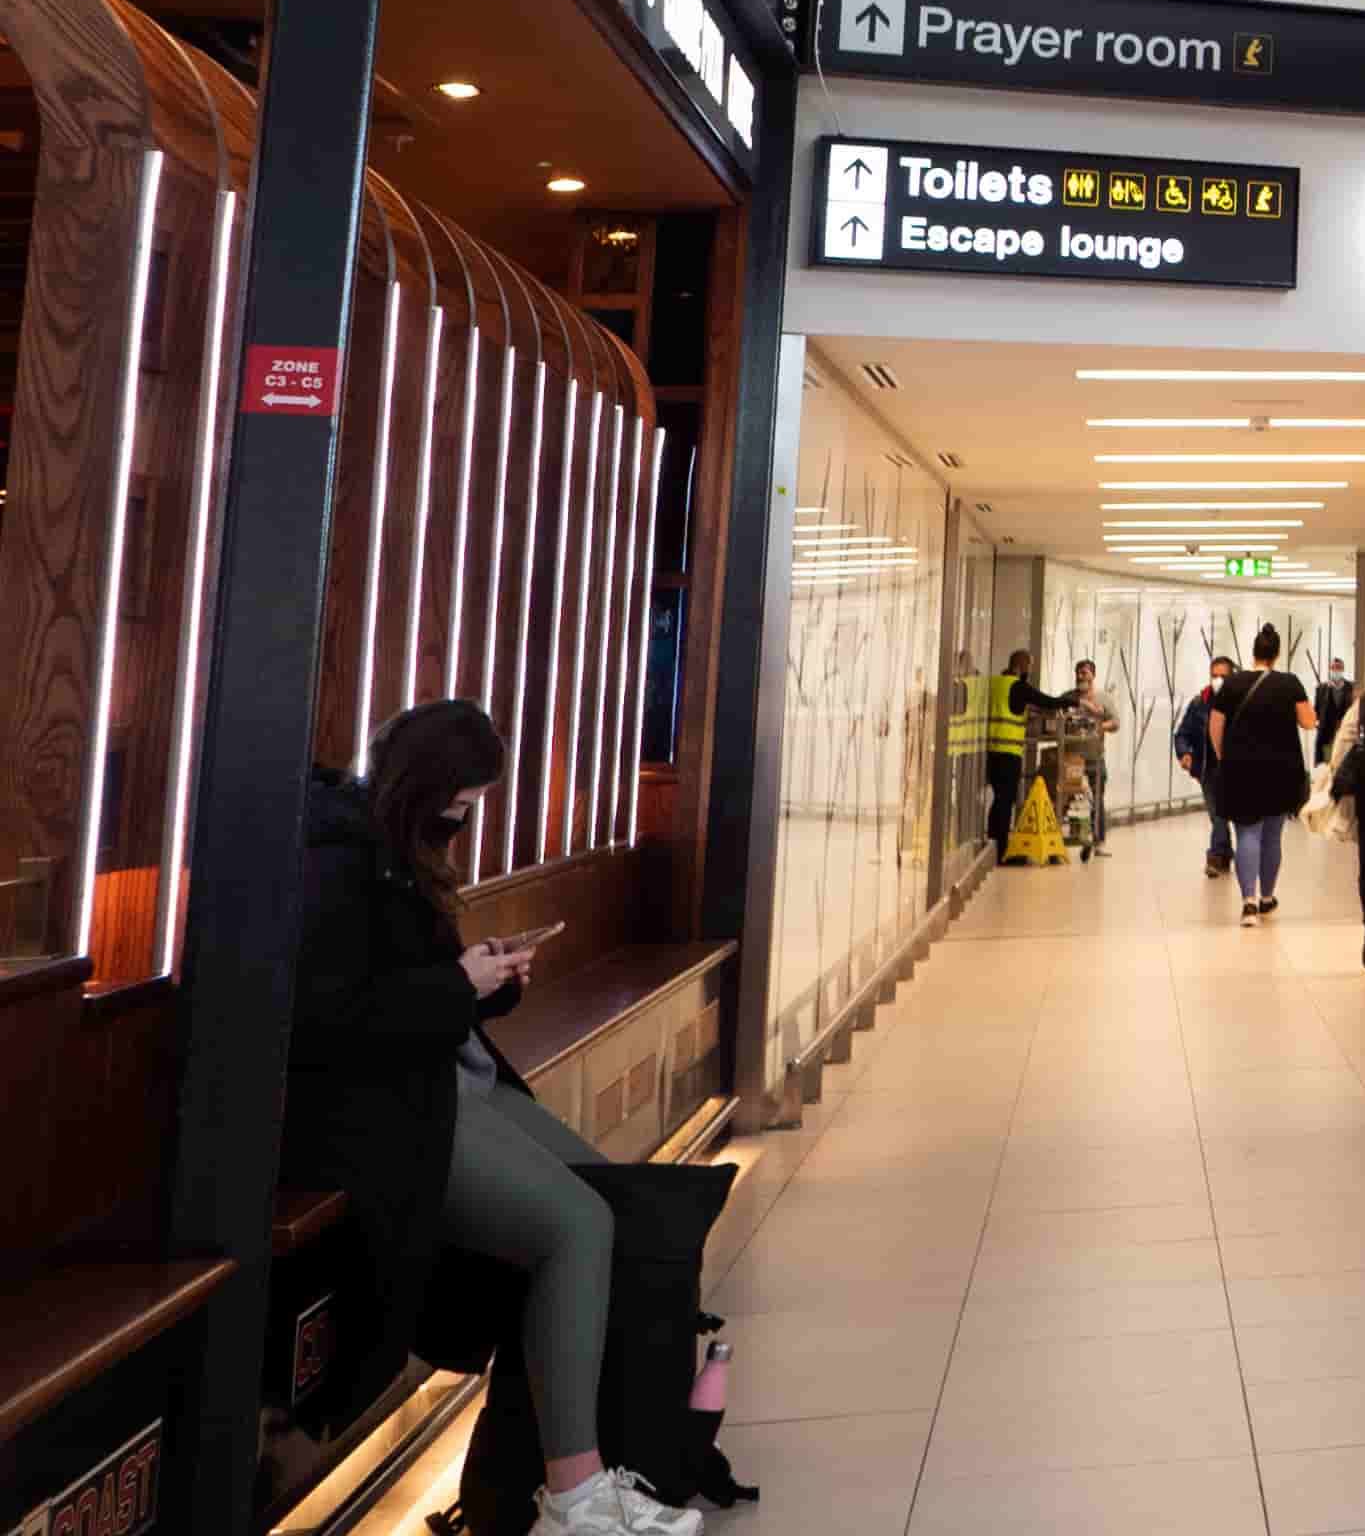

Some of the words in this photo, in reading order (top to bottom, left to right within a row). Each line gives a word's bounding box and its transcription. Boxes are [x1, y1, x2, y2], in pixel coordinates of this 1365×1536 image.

[917, 4, 1084, 66] Prayer
[1095, 31, 1222, 72] room
[899, 156, 1054, 206] Toilets
[900, 215, 1045, 261] Escape
[1060, 224, 1185, 270] lounge
[264, 374, 287, 388] C3
[301, 376, 324, 389] C5
[271, 359, 321, 374] ZONE
